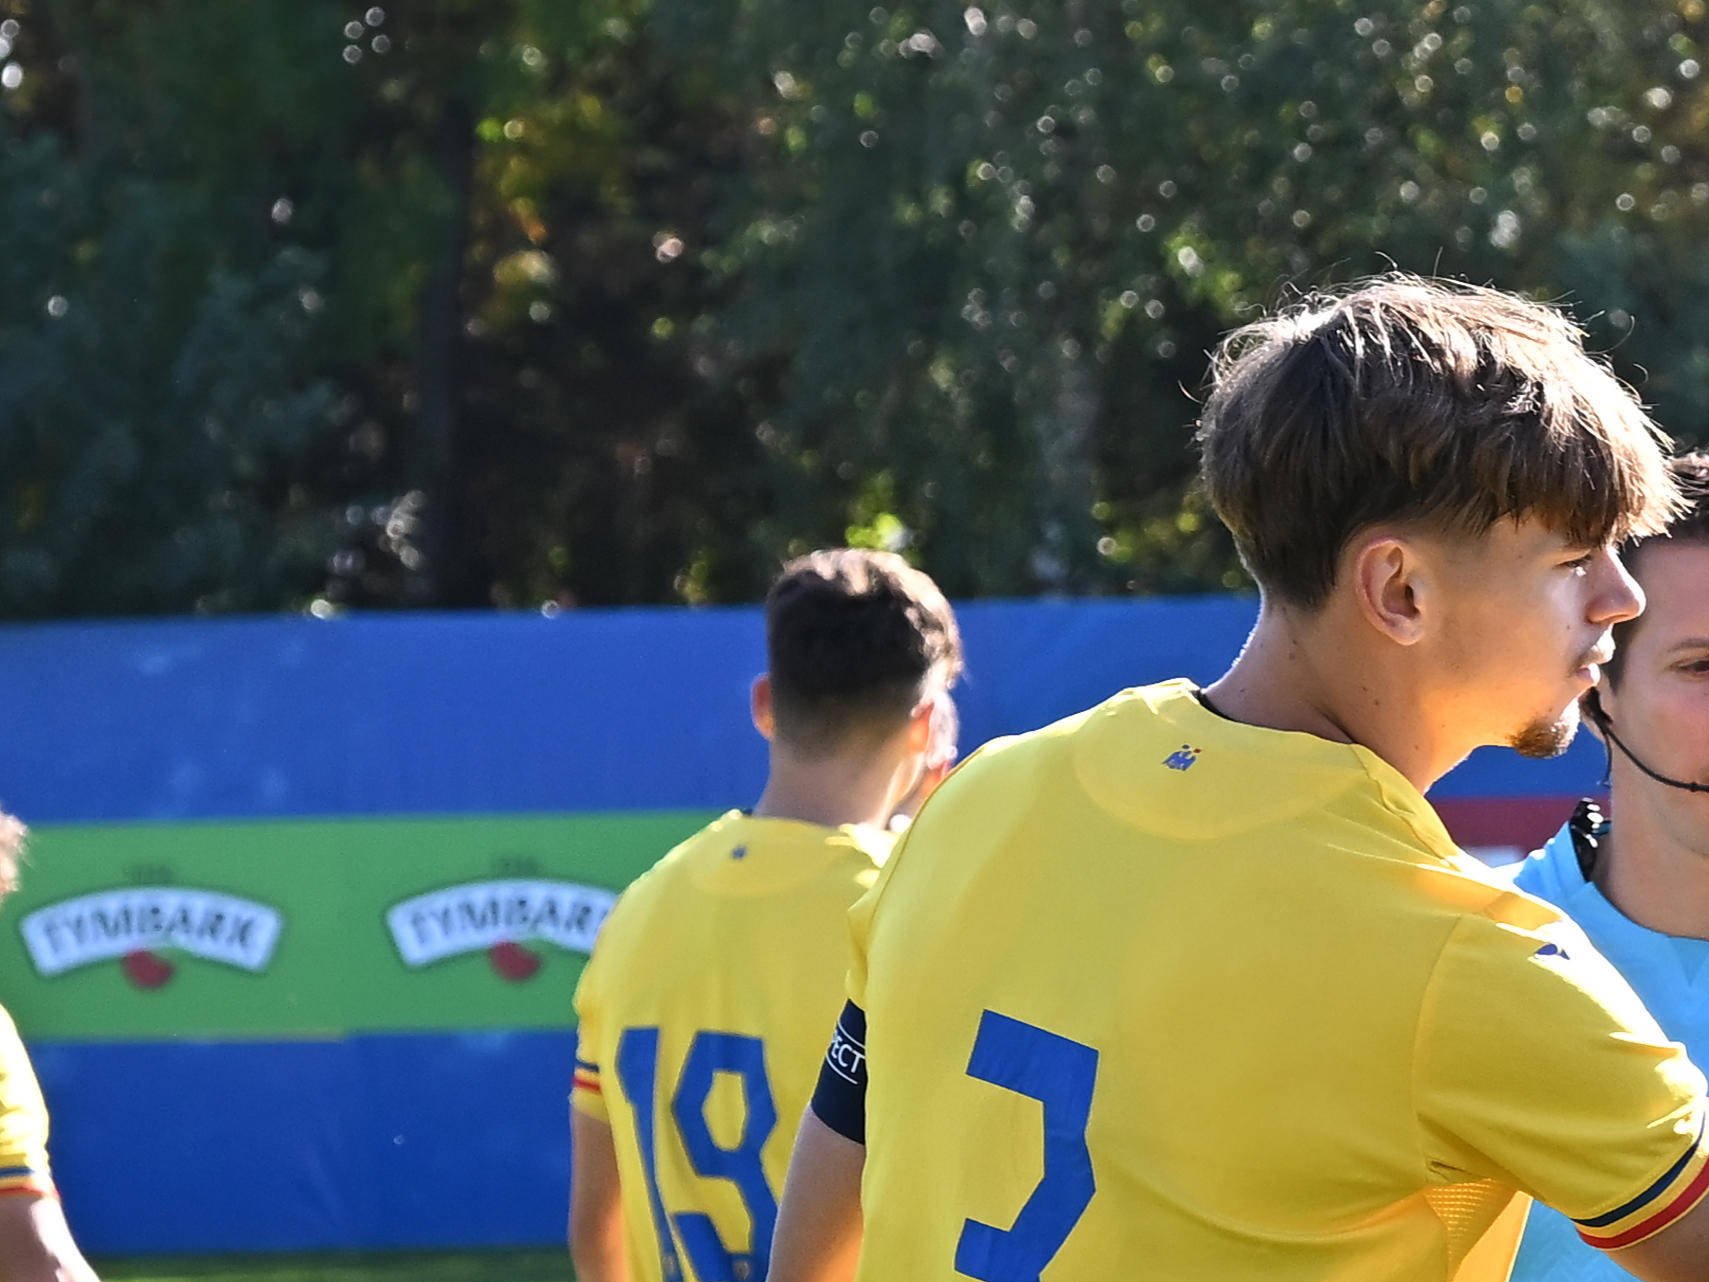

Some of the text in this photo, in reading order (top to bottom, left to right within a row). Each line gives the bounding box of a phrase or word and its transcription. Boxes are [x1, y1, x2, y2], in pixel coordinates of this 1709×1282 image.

[43, 903, 255, 953] TYMBARK
[411, 896, 608, 945] TYMBAR
[831, 1030, 866, 1074] ECT
